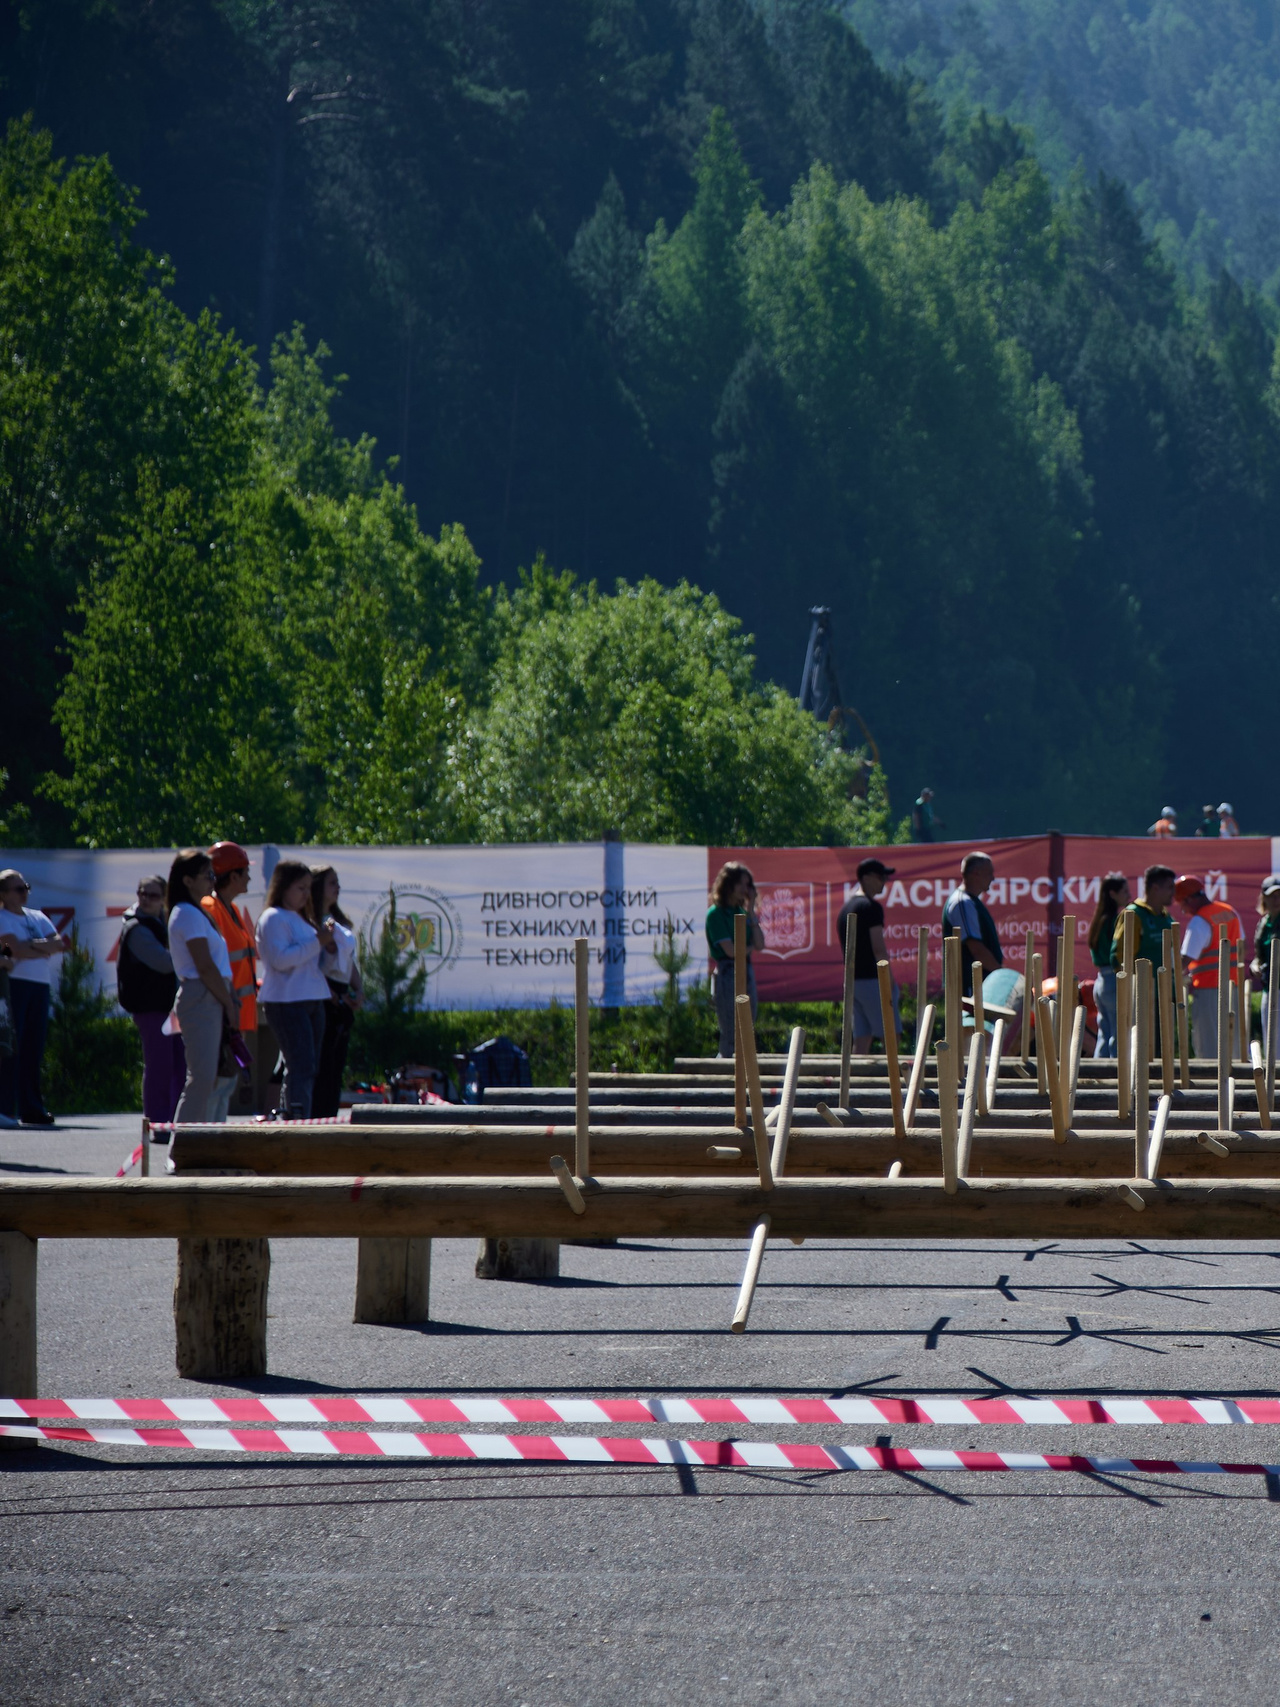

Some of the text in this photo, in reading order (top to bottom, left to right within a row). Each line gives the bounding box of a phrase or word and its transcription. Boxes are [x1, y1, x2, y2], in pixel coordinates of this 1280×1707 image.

[481, 886, 657, 912] ДИВНОГОРСКИЙ
[482, 918, 695, 938] ТЕХНИКУМ ЛЕСНЫХ
